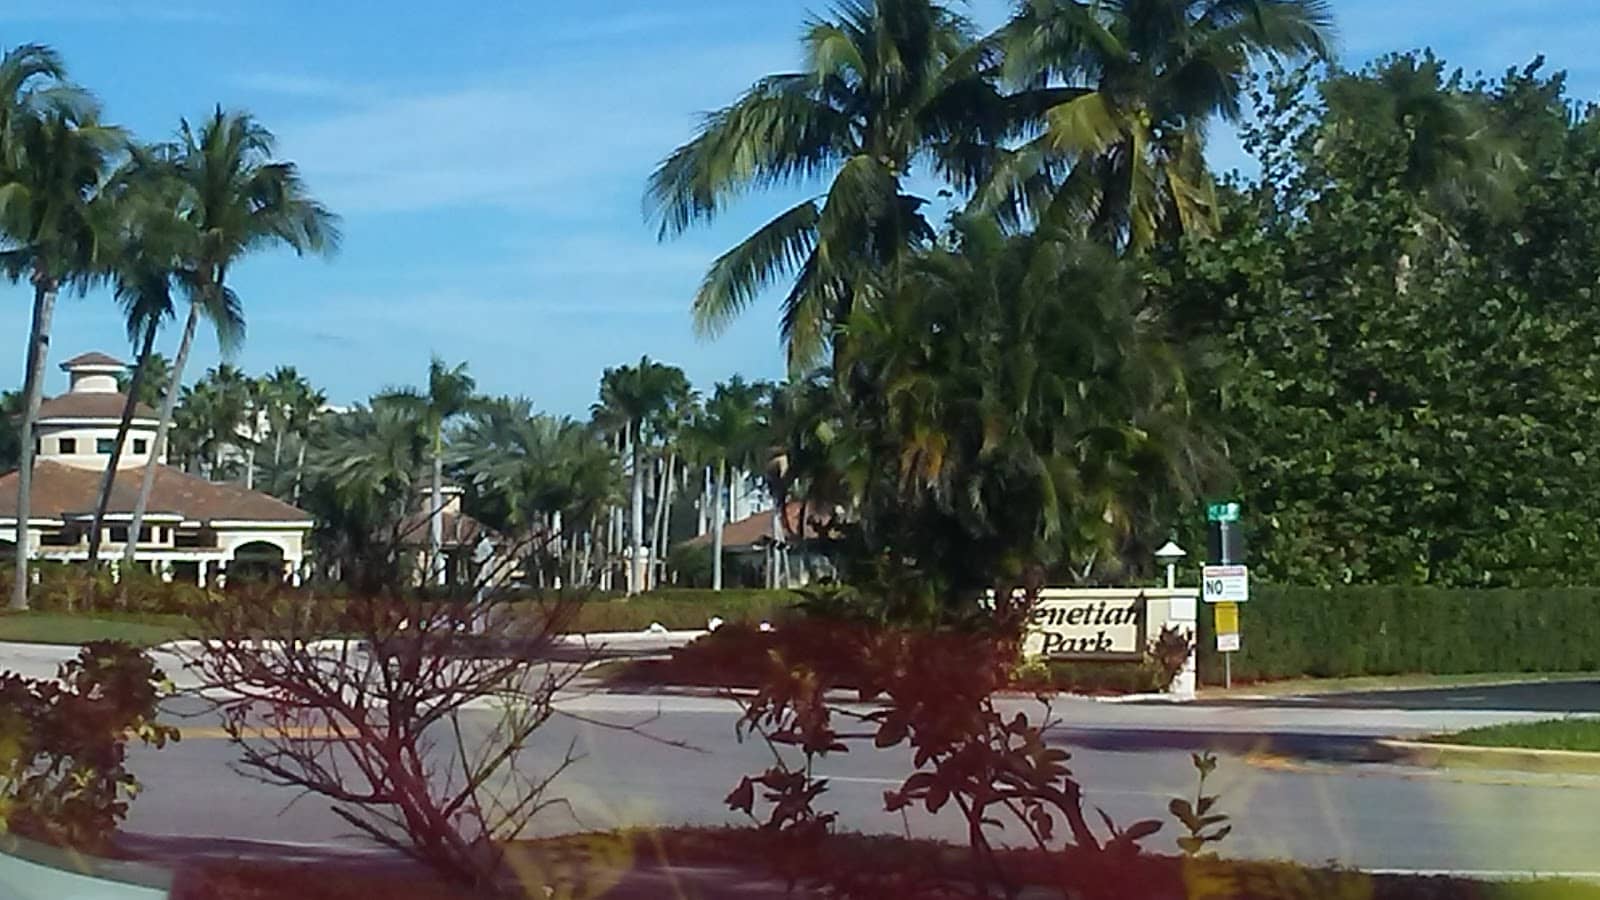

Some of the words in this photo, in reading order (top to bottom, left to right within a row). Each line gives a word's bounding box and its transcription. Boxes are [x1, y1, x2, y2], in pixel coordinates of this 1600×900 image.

[1206, 579, 1224, 595] NO
[1031, 600, 1138, 626] enetian
[1040, 630, 1113, 655] Park
